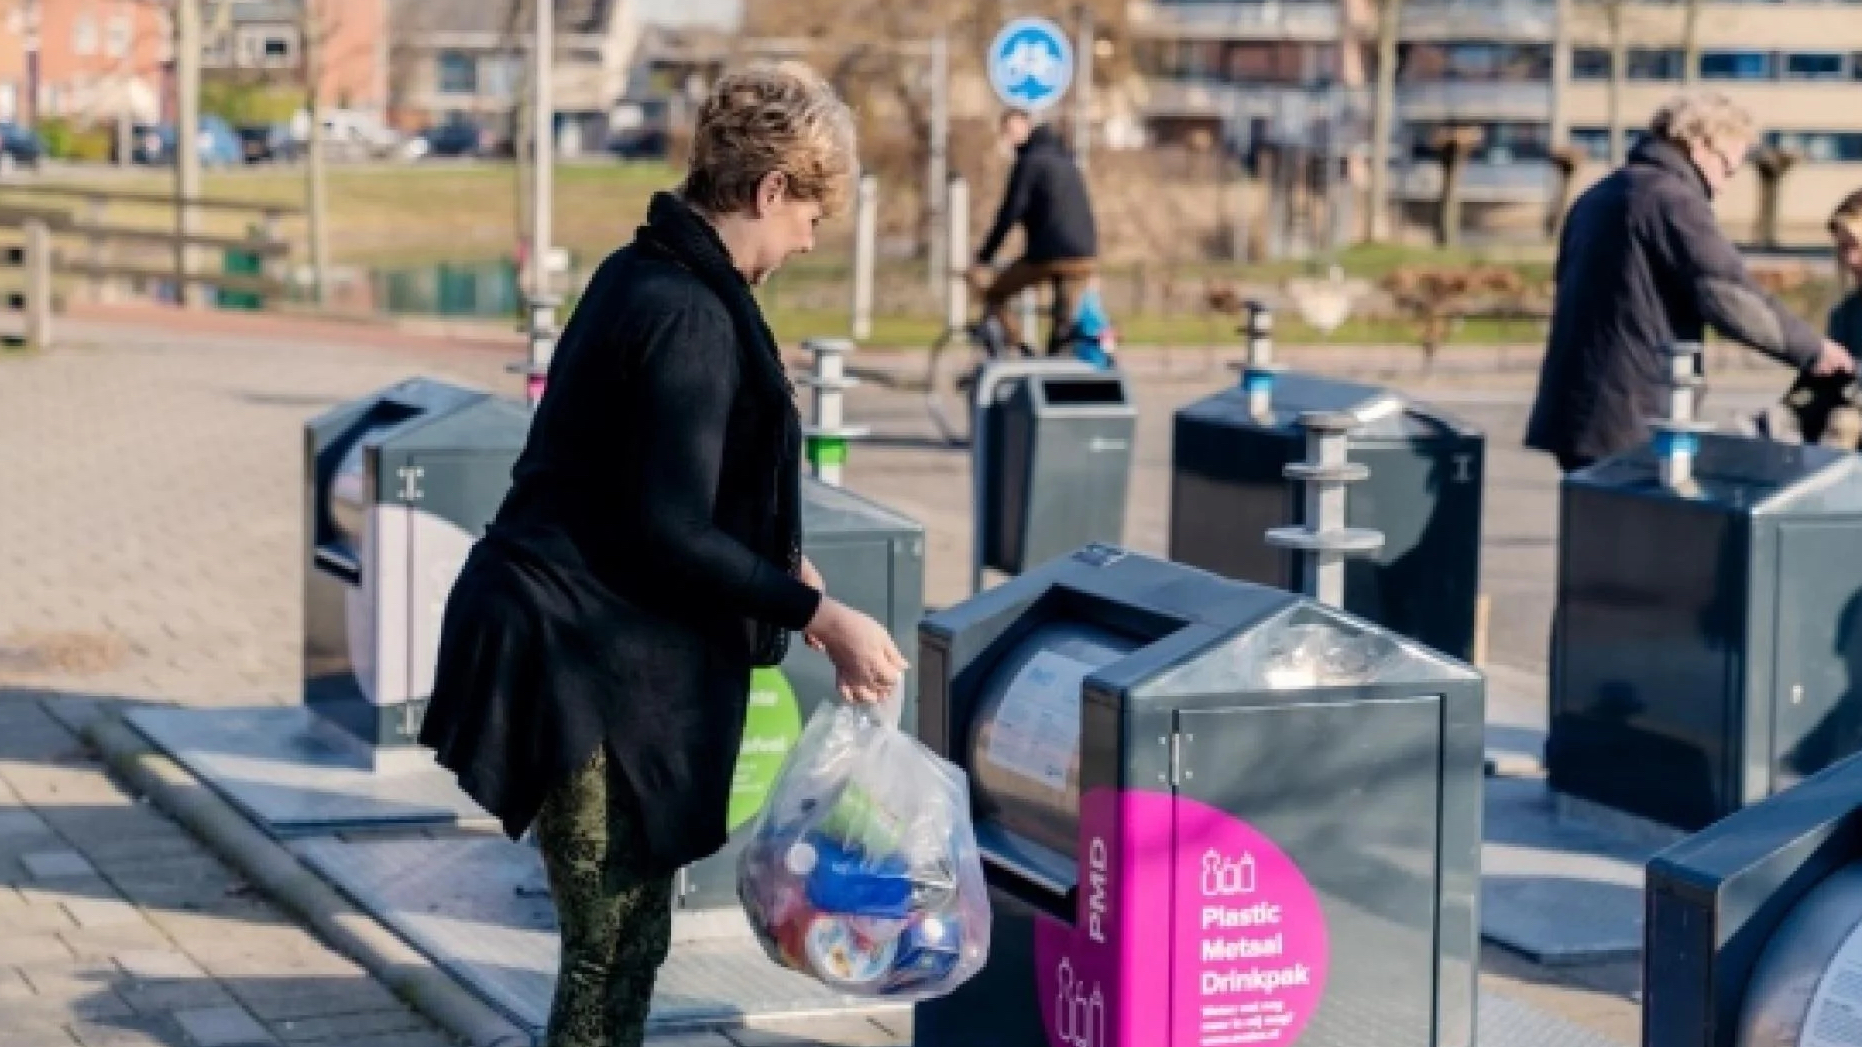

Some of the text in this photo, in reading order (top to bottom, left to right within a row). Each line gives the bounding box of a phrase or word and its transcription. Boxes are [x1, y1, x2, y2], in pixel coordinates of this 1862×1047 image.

[1089, 837, 1107, 943] PMD
[1202, 902, 1282, 929] Plastic
[1202, 933, 1282, 961] Metaal
[1202, 963, 1310, 995] Drinkpak
